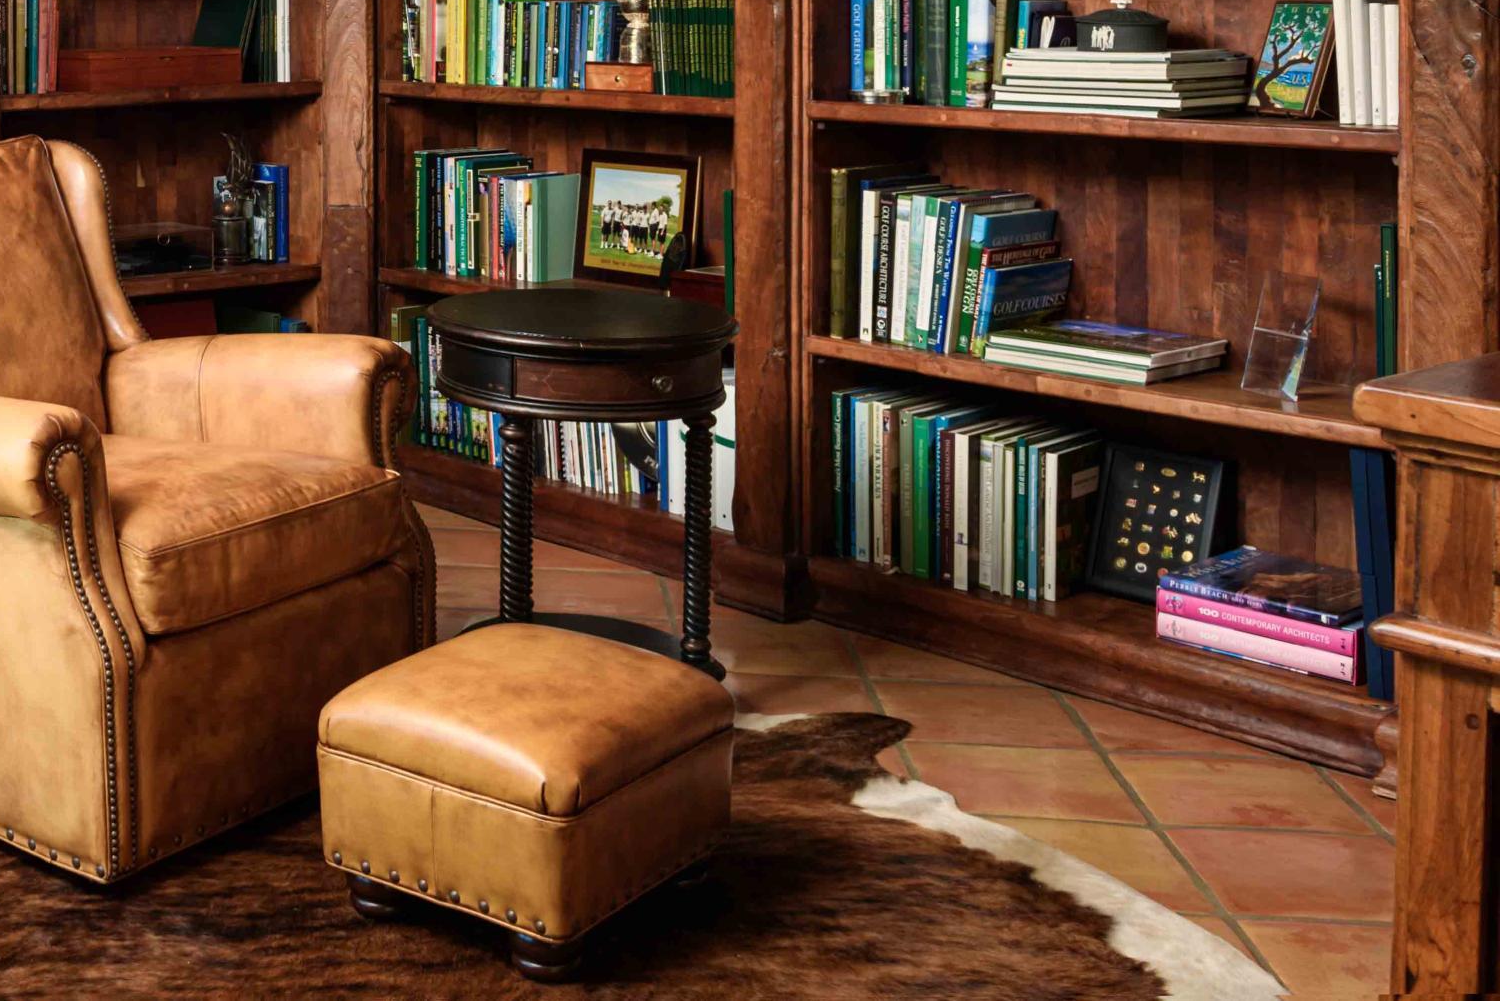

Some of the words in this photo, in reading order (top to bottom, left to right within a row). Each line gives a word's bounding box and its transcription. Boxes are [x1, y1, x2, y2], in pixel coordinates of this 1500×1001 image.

[853, 3, 861, 27] GOLF
[853, 30, 861, 65] GREENS
[881, 205, 890, 224] GOLF
[880, 224, 889, 251] COURSE
[936, 245, 944, 274] DESIGN
[878, 251, 888, 304] ARCHITECTURE
[962, 269, 973, 314] DESIGN
[971, 269, 979, 285] GOLF
[968, 285, 978, 314] COURSE
[1169, 580, 1199, 593] PEBBLE
[1200, 587, 1228, 599] BEACH
[1197, 607, 1220, 618] 100
[1221, 611, 1281, 632] CONTEMPORARY
[1283, 626, 1330, 645] ARCHITECTS
